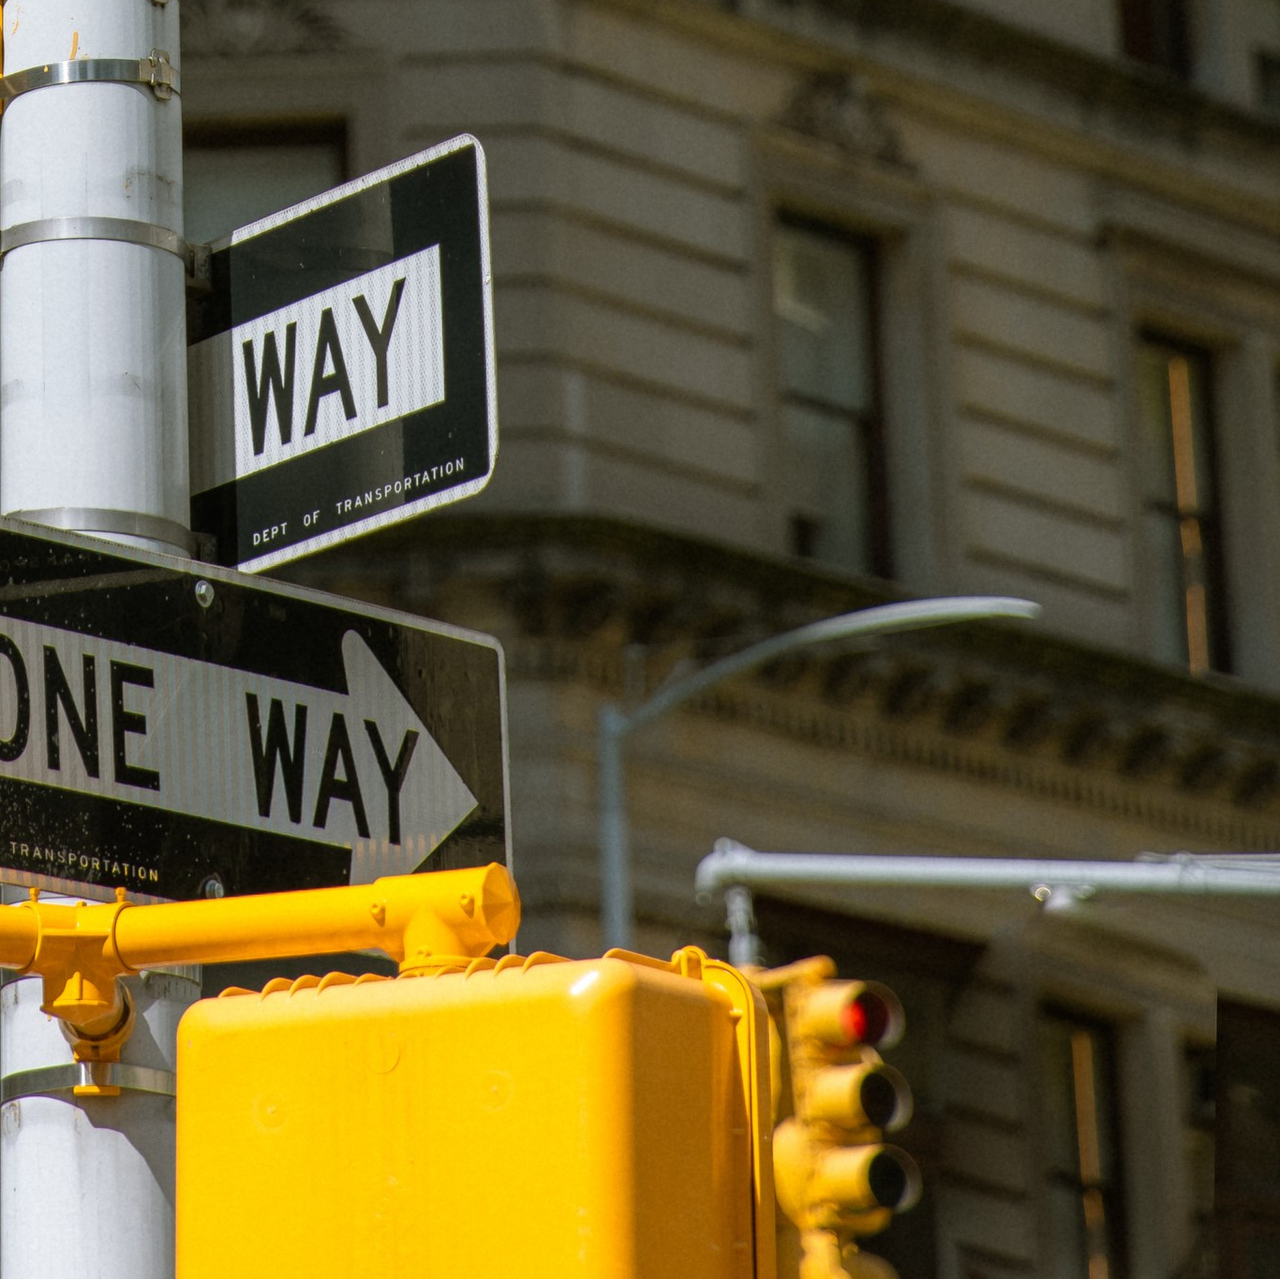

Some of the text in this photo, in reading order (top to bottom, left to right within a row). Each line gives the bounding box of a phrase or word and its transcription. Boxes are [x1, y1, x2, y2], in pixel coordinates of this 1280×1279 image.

[242, 277, 406, 458] WAY
[252, 457, 466, 546] DEPT OF TRANSPORTATION
[245, 691, 420, 845] WAY
[10, 841, 159, 882] TRANSPORTATION
